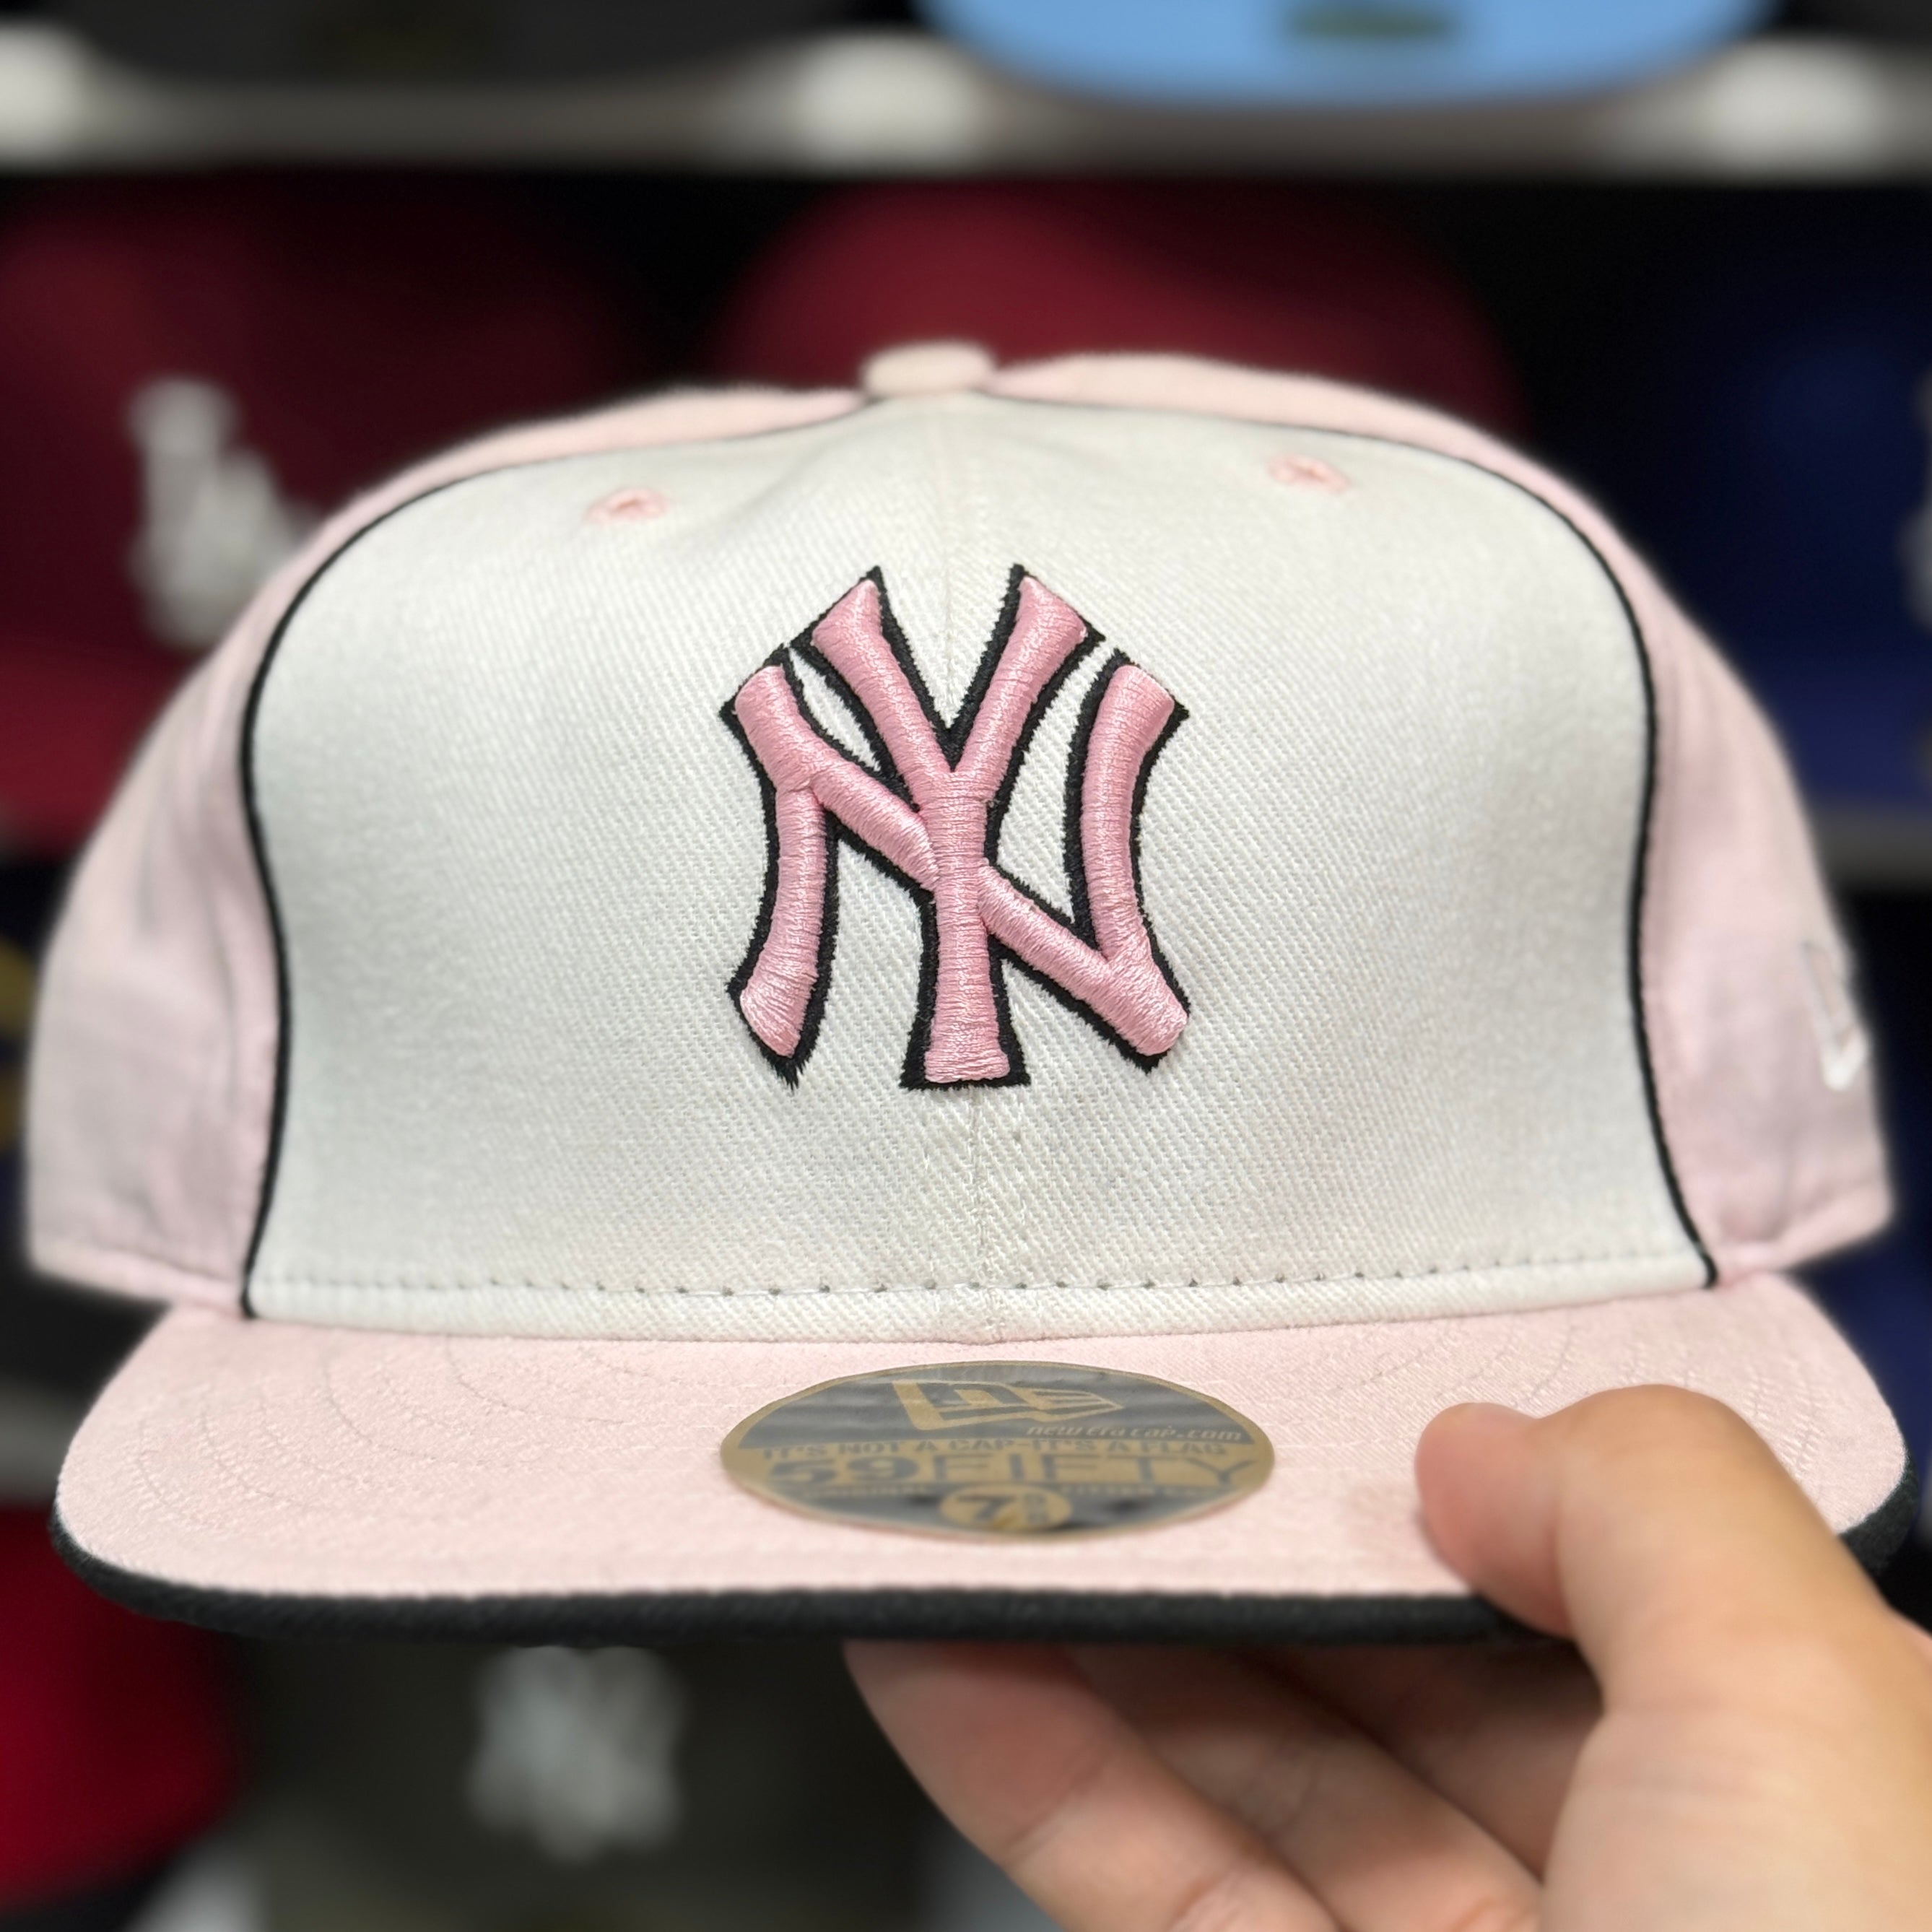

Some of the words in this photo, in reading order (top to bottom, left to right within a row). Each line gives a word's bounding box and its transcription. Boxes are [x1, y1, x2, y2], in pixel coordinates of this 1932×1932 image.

[720, 564, 1190, 1089] NY
[763, 1444, 828, 1459] IT'S
[837, 1440, 907, 1454] NOT
[915, 1439, 938, 1453] A
[1107, 1440, 1130, 1452] A
[1138, 1442, 1227, 1455] FLAG
[770, 1453, 1256, 1486] 59FIFTY
